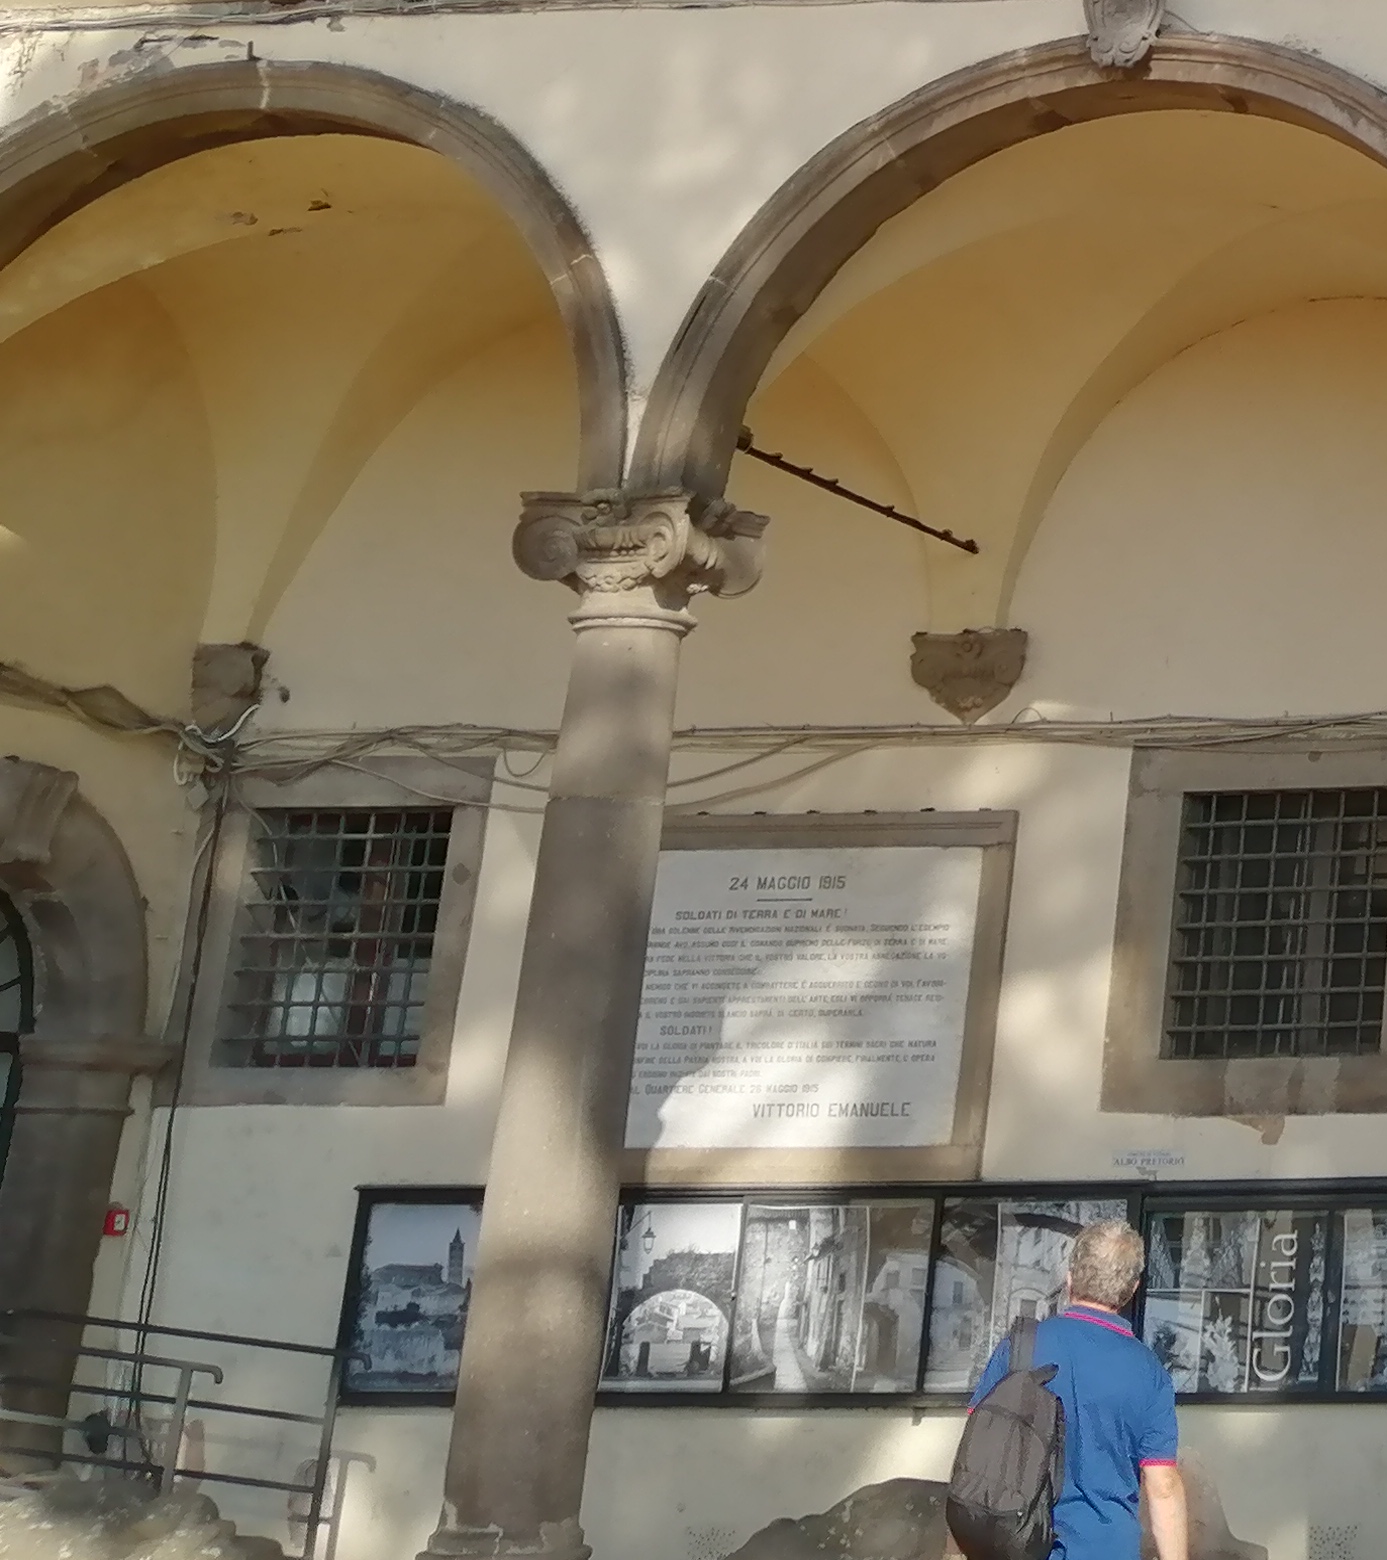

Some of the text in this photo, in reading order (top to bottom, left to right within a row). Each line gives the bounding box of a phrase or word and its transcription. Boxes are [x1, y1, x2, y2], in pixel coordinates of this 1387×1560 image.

[728, 874, 847, 891] 24 MAGGIO 1915
[675, 910, 722, 921] SOLDATI
[726, 909, 737, 920] DI
[742, 909, 778, 920] TERRA
[783, 909, 792, 919] E
[795, 908, 807, 919] DI
[753, 1101, 911, 1118] VITTORIO EMANUELE
[1252, 1230, 1299, 1382] Gloria
